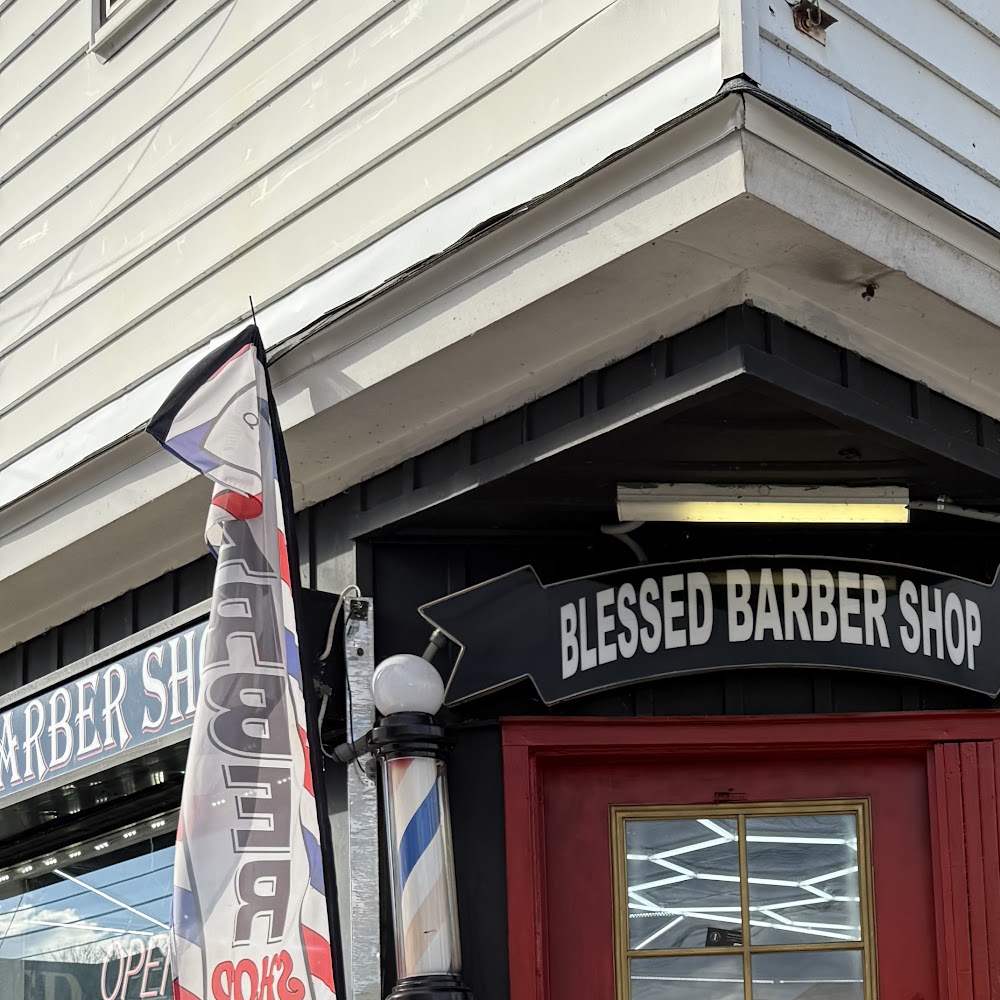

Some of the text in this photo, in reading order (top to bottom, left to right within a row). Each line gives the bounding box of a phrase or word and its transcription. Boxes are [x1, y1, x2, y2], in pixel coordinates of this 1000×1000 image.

[560, 568, 983, 680] BLESSED BARBER SHOP
[0, 625, 209, 791] ARBER SH
